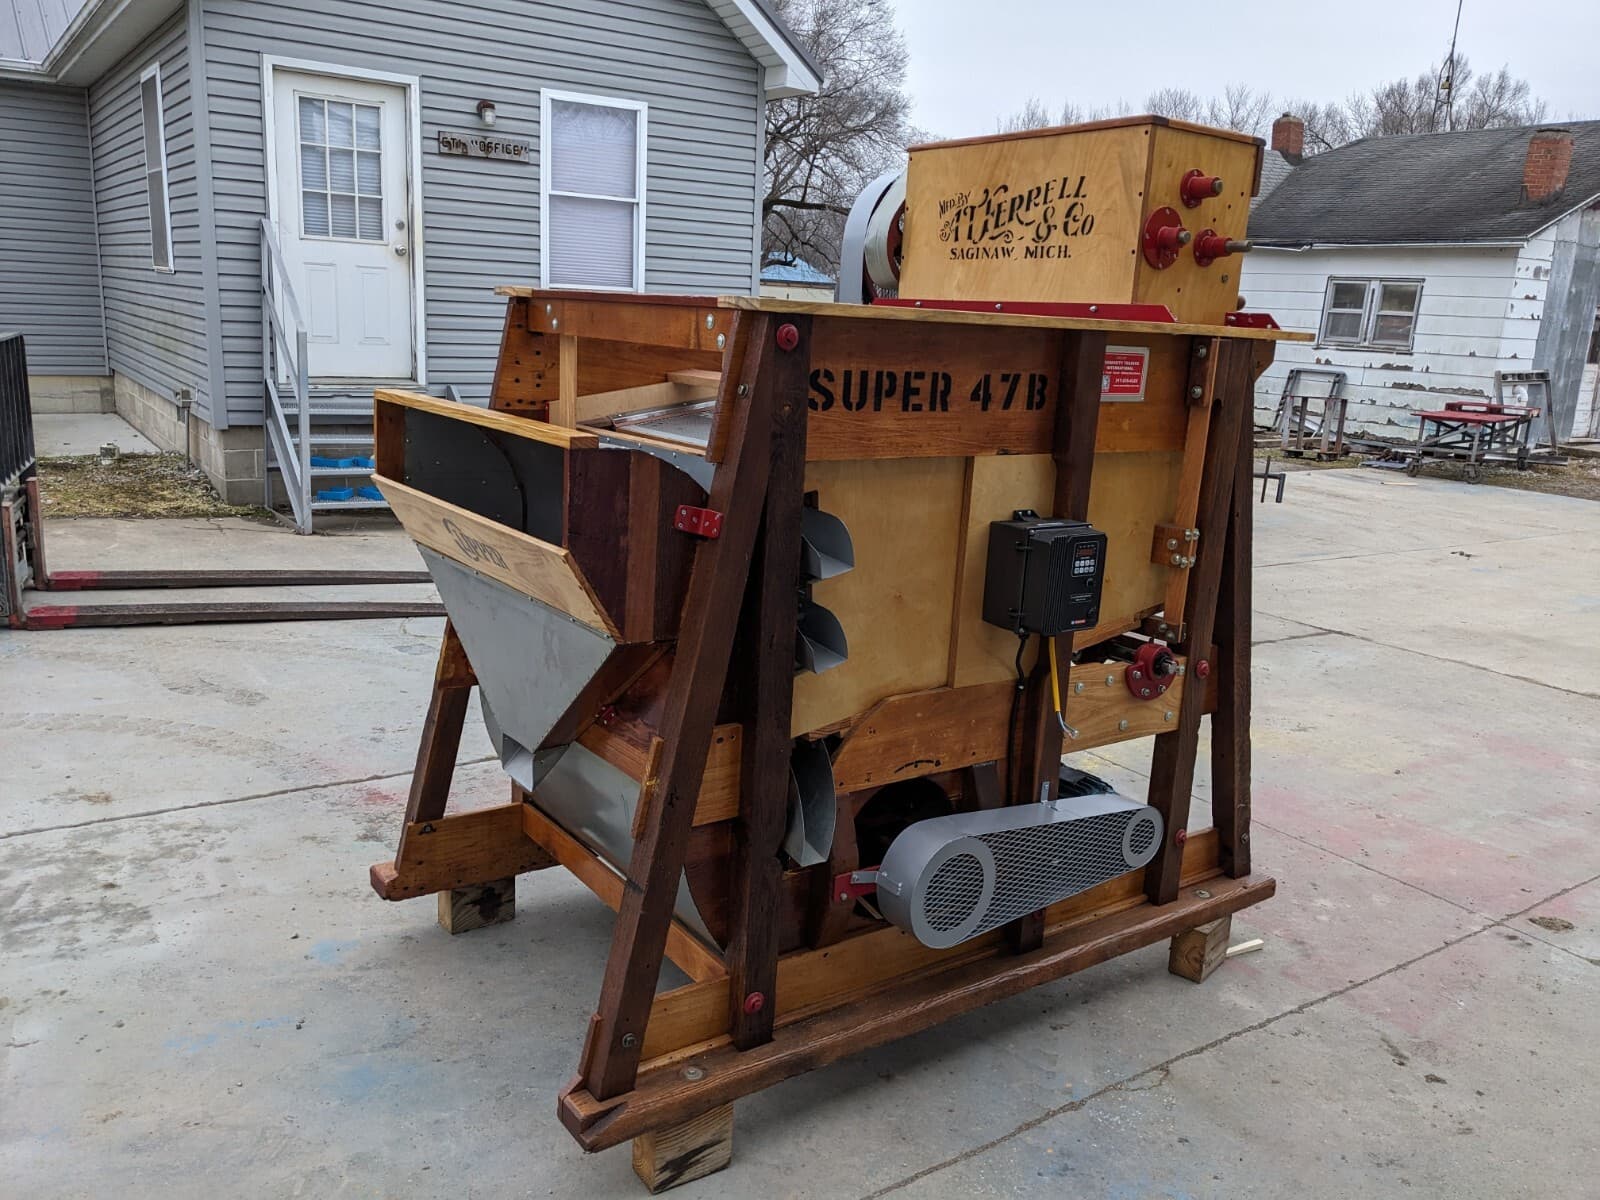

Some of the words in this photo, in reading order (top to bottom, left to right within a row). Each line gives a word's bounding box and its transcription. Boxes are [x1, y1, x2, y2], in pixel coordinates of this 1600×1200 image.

[1024, 245, 1072, 260] MICH.
[808, 368, 952, 412] SUPER
[969, 373, 1049, 412] 47B
